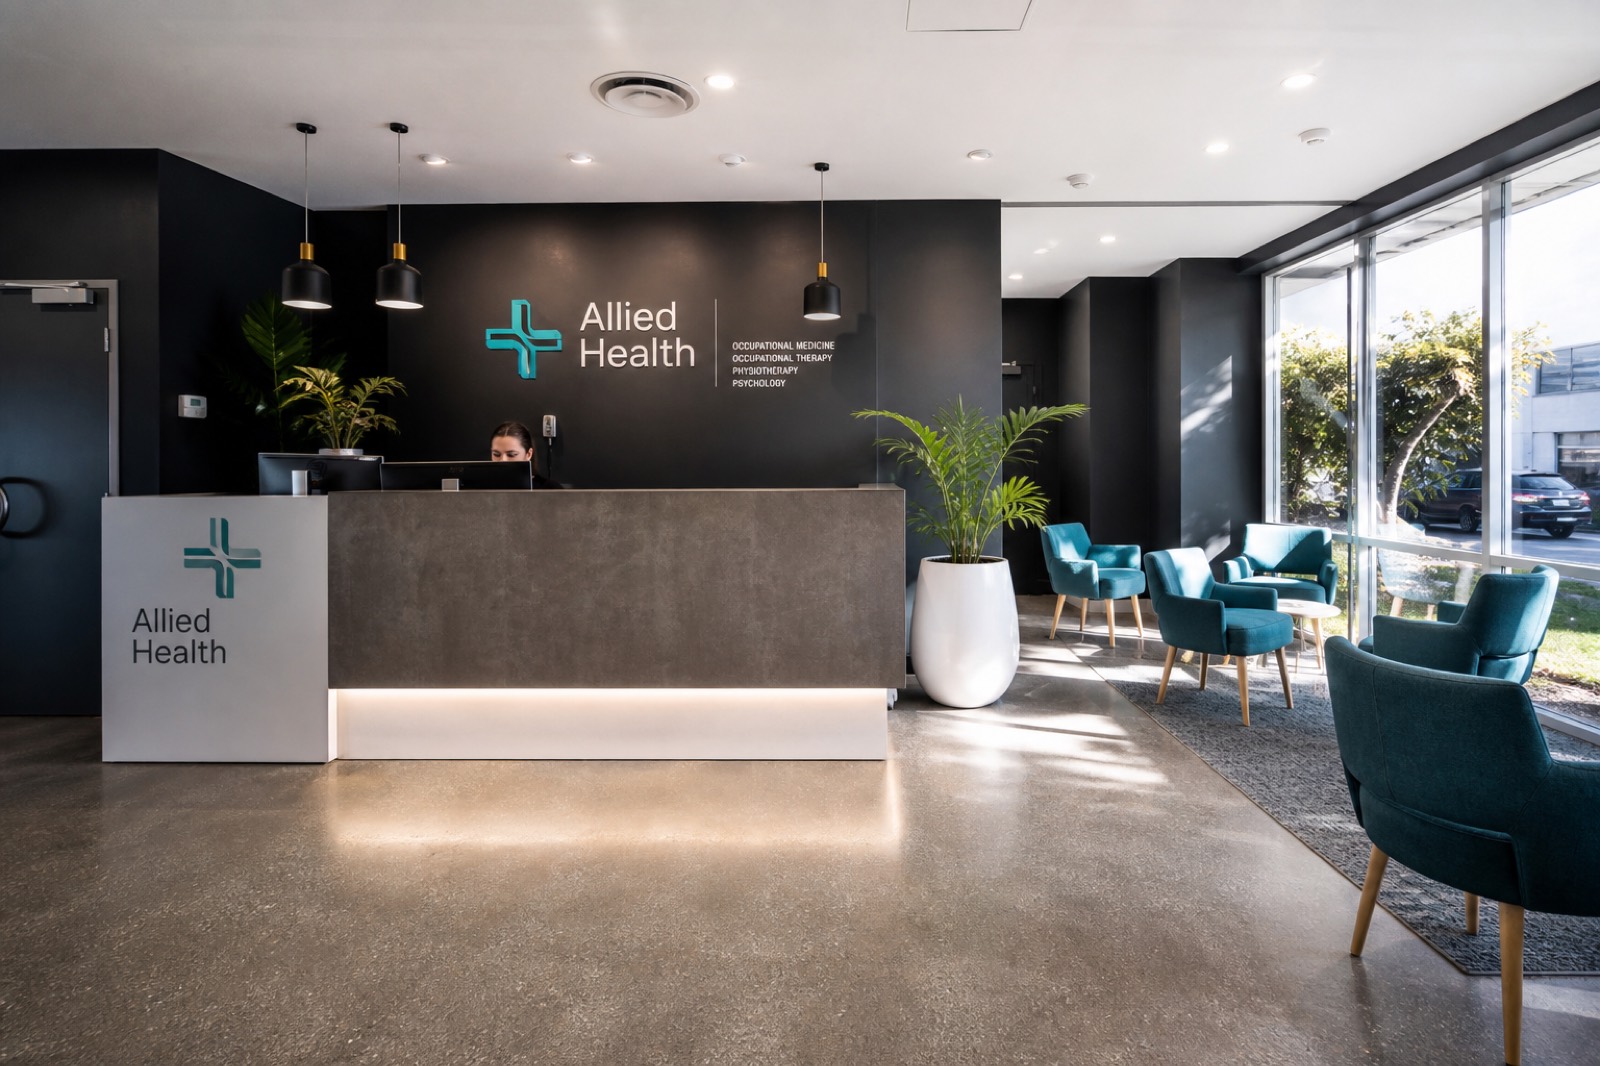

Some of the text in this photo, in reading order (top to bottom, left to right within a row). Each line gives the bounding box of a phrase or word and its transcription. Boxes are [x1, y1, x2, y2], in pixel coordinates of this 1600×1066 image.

[579, 301, 677, 331] Allied
[579, 337, 696, 368] Health
[732, 341, 835, 351] OCCUPATIONAL MEDICINE
[732, 353, 833, 362] OCCUPATIONAL THERAPY
[732, 366, 799, 375] PHYSIOTHERAPY
[732, 379, 786, 387] PSYCHOLOGY
[132, 607, 210, 633] Allied
[132, 638, 226, 664] Health
